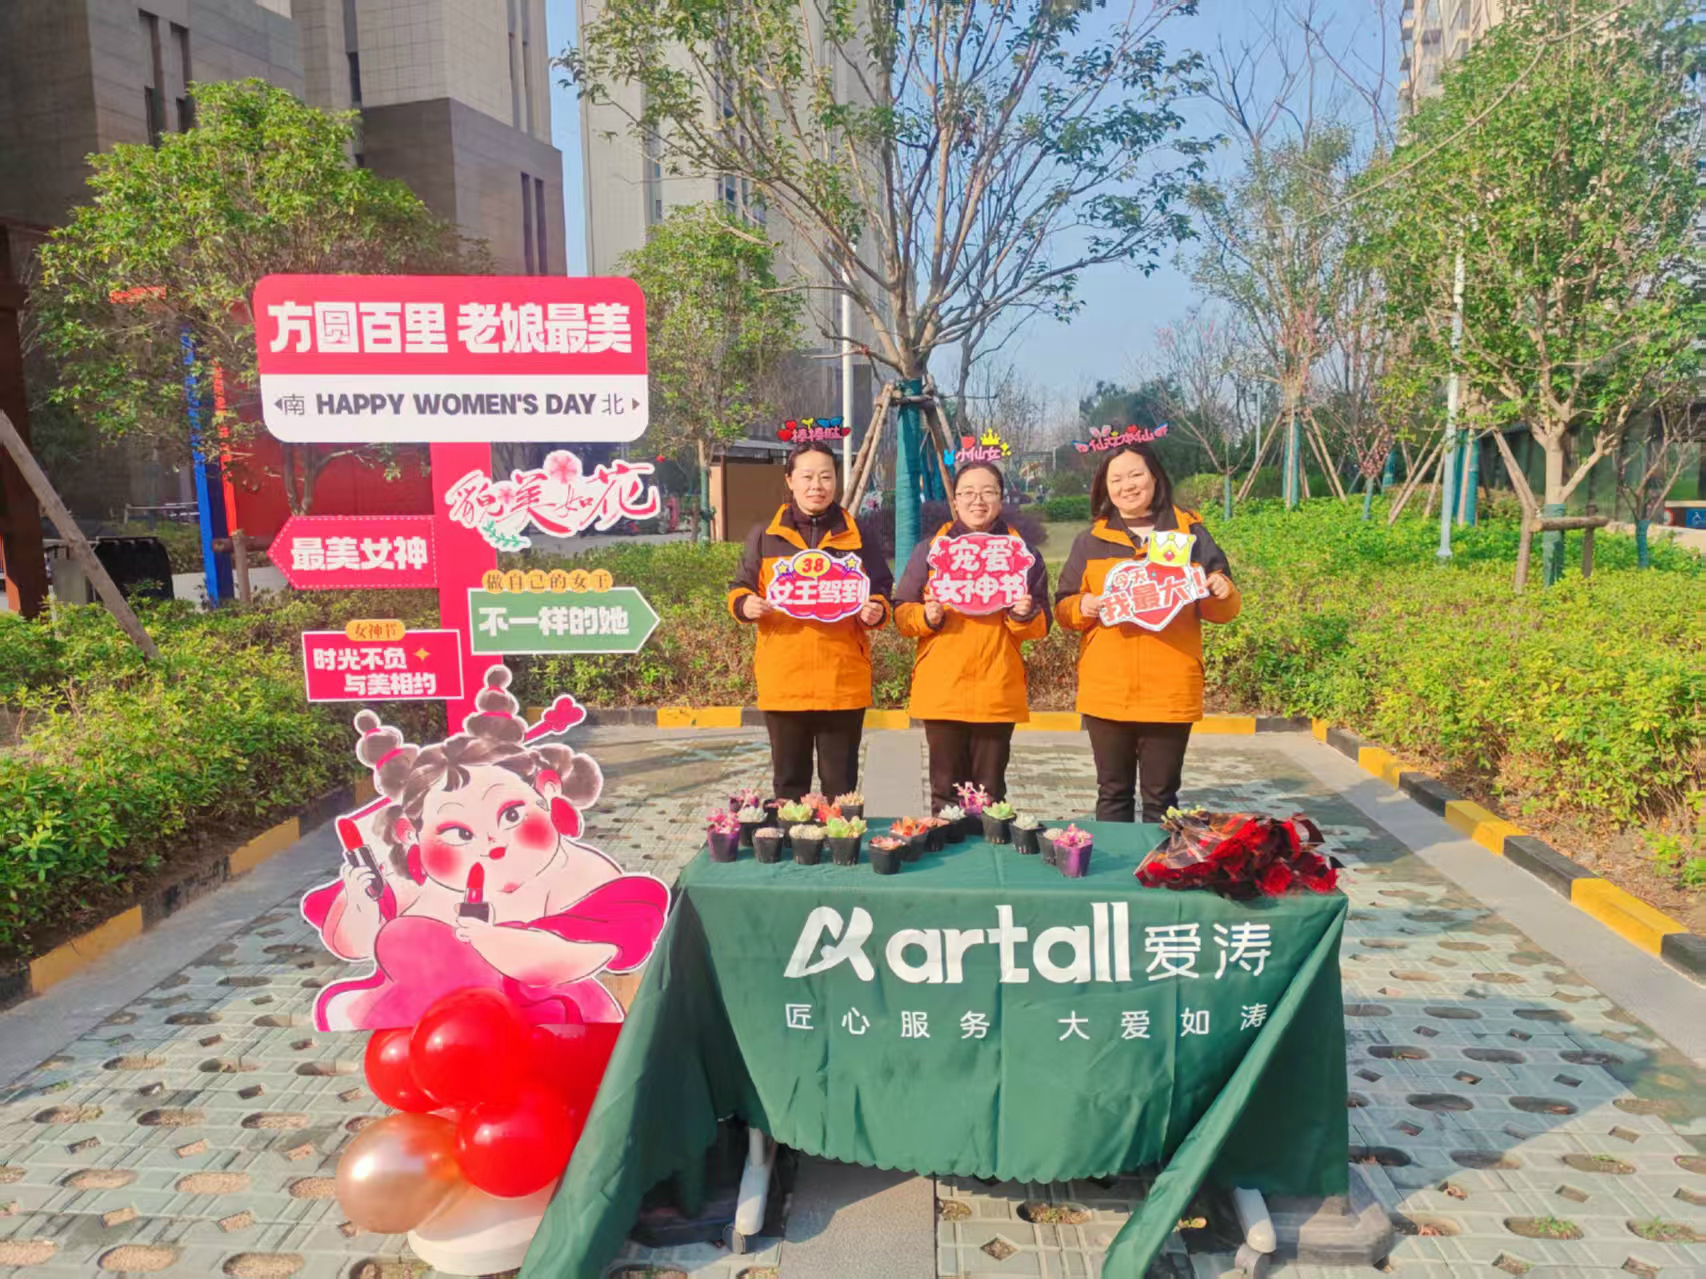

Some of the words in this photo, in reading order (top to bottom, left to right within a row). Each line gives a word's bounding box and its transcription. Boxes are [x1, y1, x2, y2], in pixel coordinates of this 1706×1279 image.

[267, 301, 448, 354] 方圆百里
[457, 303, 632, 354] 老娘最美
[282, 394, 305, 416] 南
[317, 394, 404, 414] HAPPY
[412, 394, 538, 415] WOMEN'S
[546, 394, 596, 414] DAY
[601, 394, 624, 415] 北
[955, 446, 1001, 462] 小仙女
[291, 537, 428, 571] 最美女神
[948, 539, 1012, 572] 宠爱
[801, 558, 824, 573] 38
[487, 573, 610, 592] 做自己的女王
[932, 573, 1025, 604] 女神节
[1113, 569, 1149, 591] 今天
[769, 580, 868, 605] 女王驾到
[355, 623, 397, 640] 女神节
[479, 606, 630, 637] 不一样的她
[313, 648, 408, 670] 时光不负
[344, 673, 438, 696] 与美相约
[885, 901, 1133, 985] artall
[1144, 921, 1273, 981] 爱涛
[785, 1003, 991, 1040] 匠心服务
[1057, 1003, 1270, 1041] 大爱如涛
